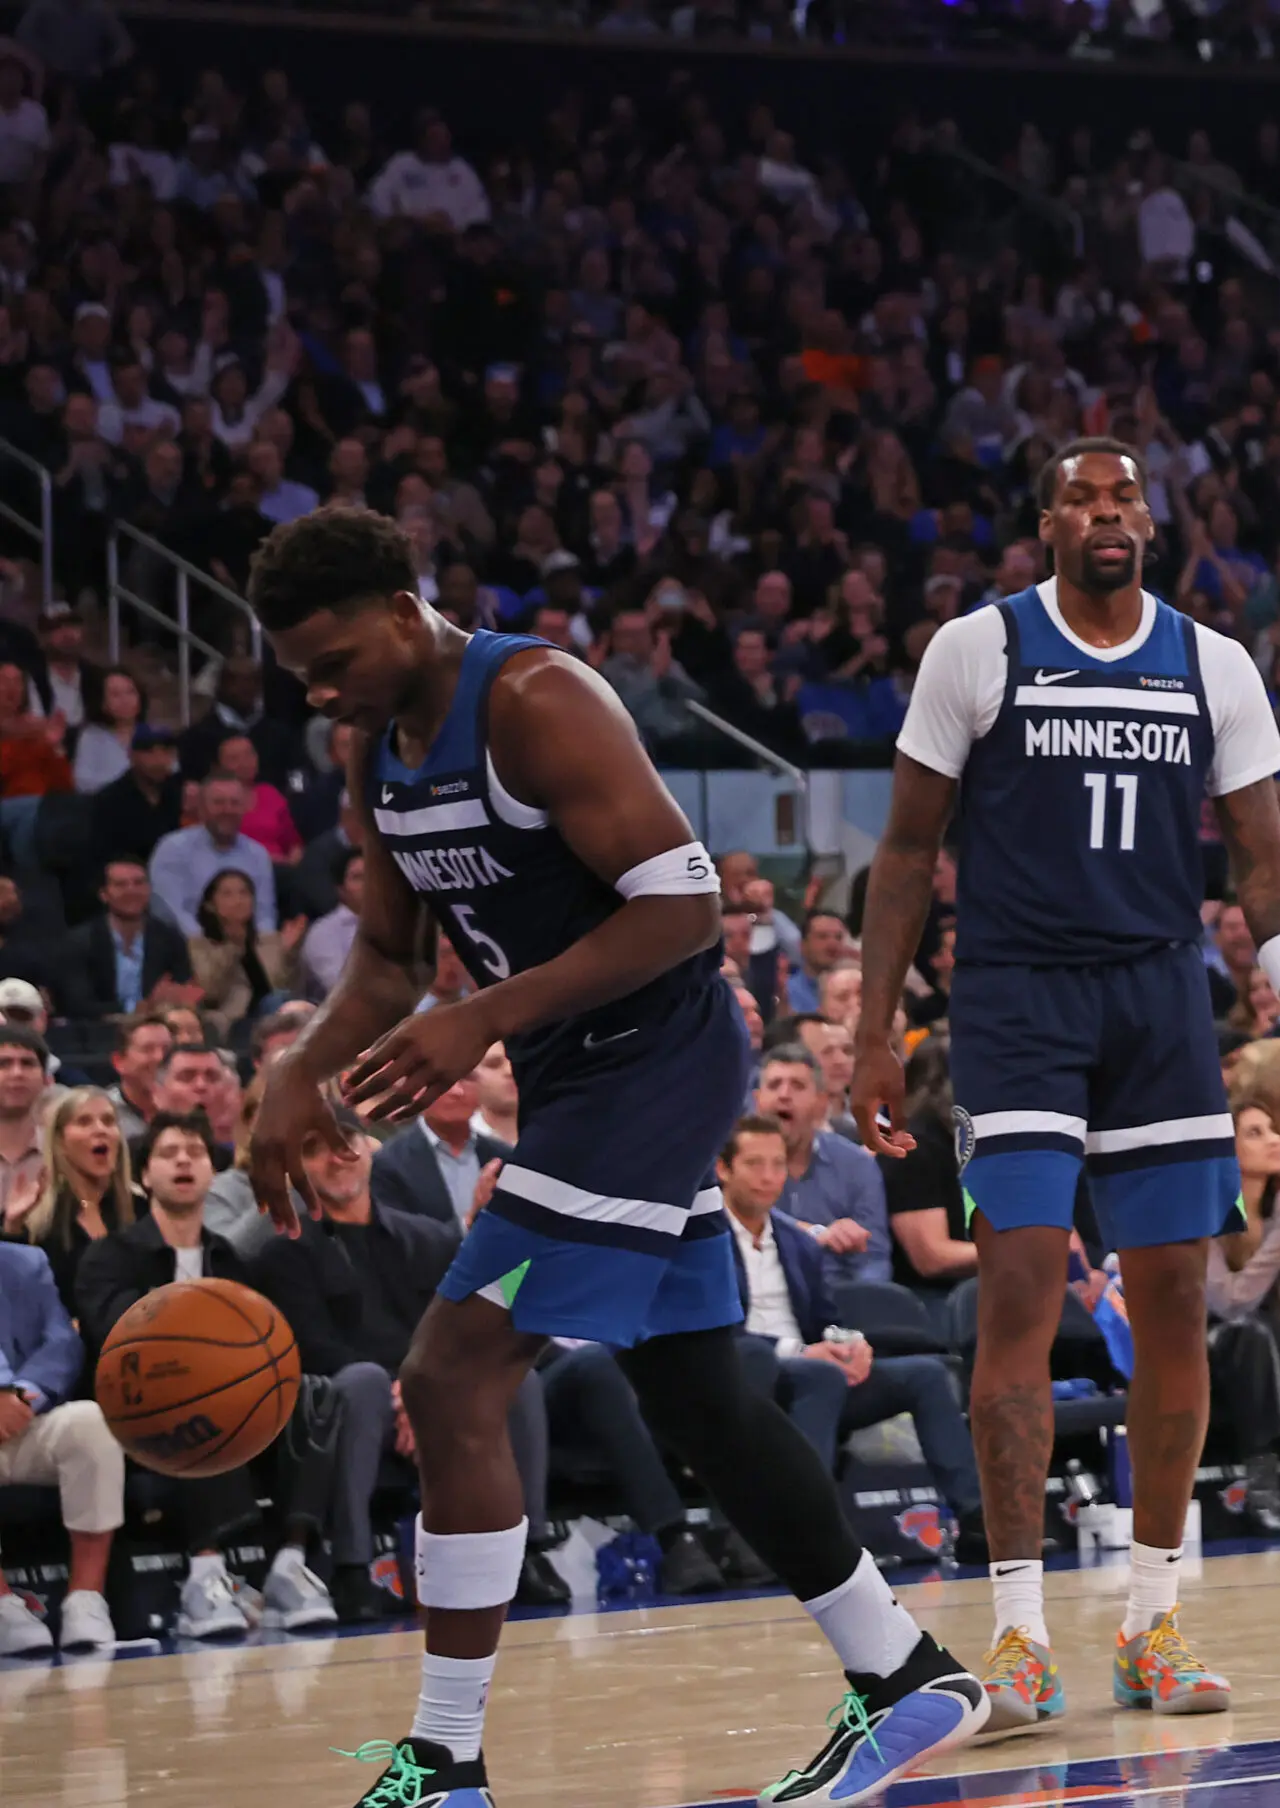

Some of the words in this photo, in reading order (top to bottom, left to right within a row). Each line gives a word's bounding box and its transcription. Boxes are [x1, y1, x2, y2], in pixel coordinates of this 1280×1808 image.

[1147, 678, 1184, 690] sezzle
[1025, 718, 1192, 766] MINNESOTA
[1084, 772, 1139, 851] 11
[686, 856, 710, 881] 5
[451, 904, 511, 980] 5
